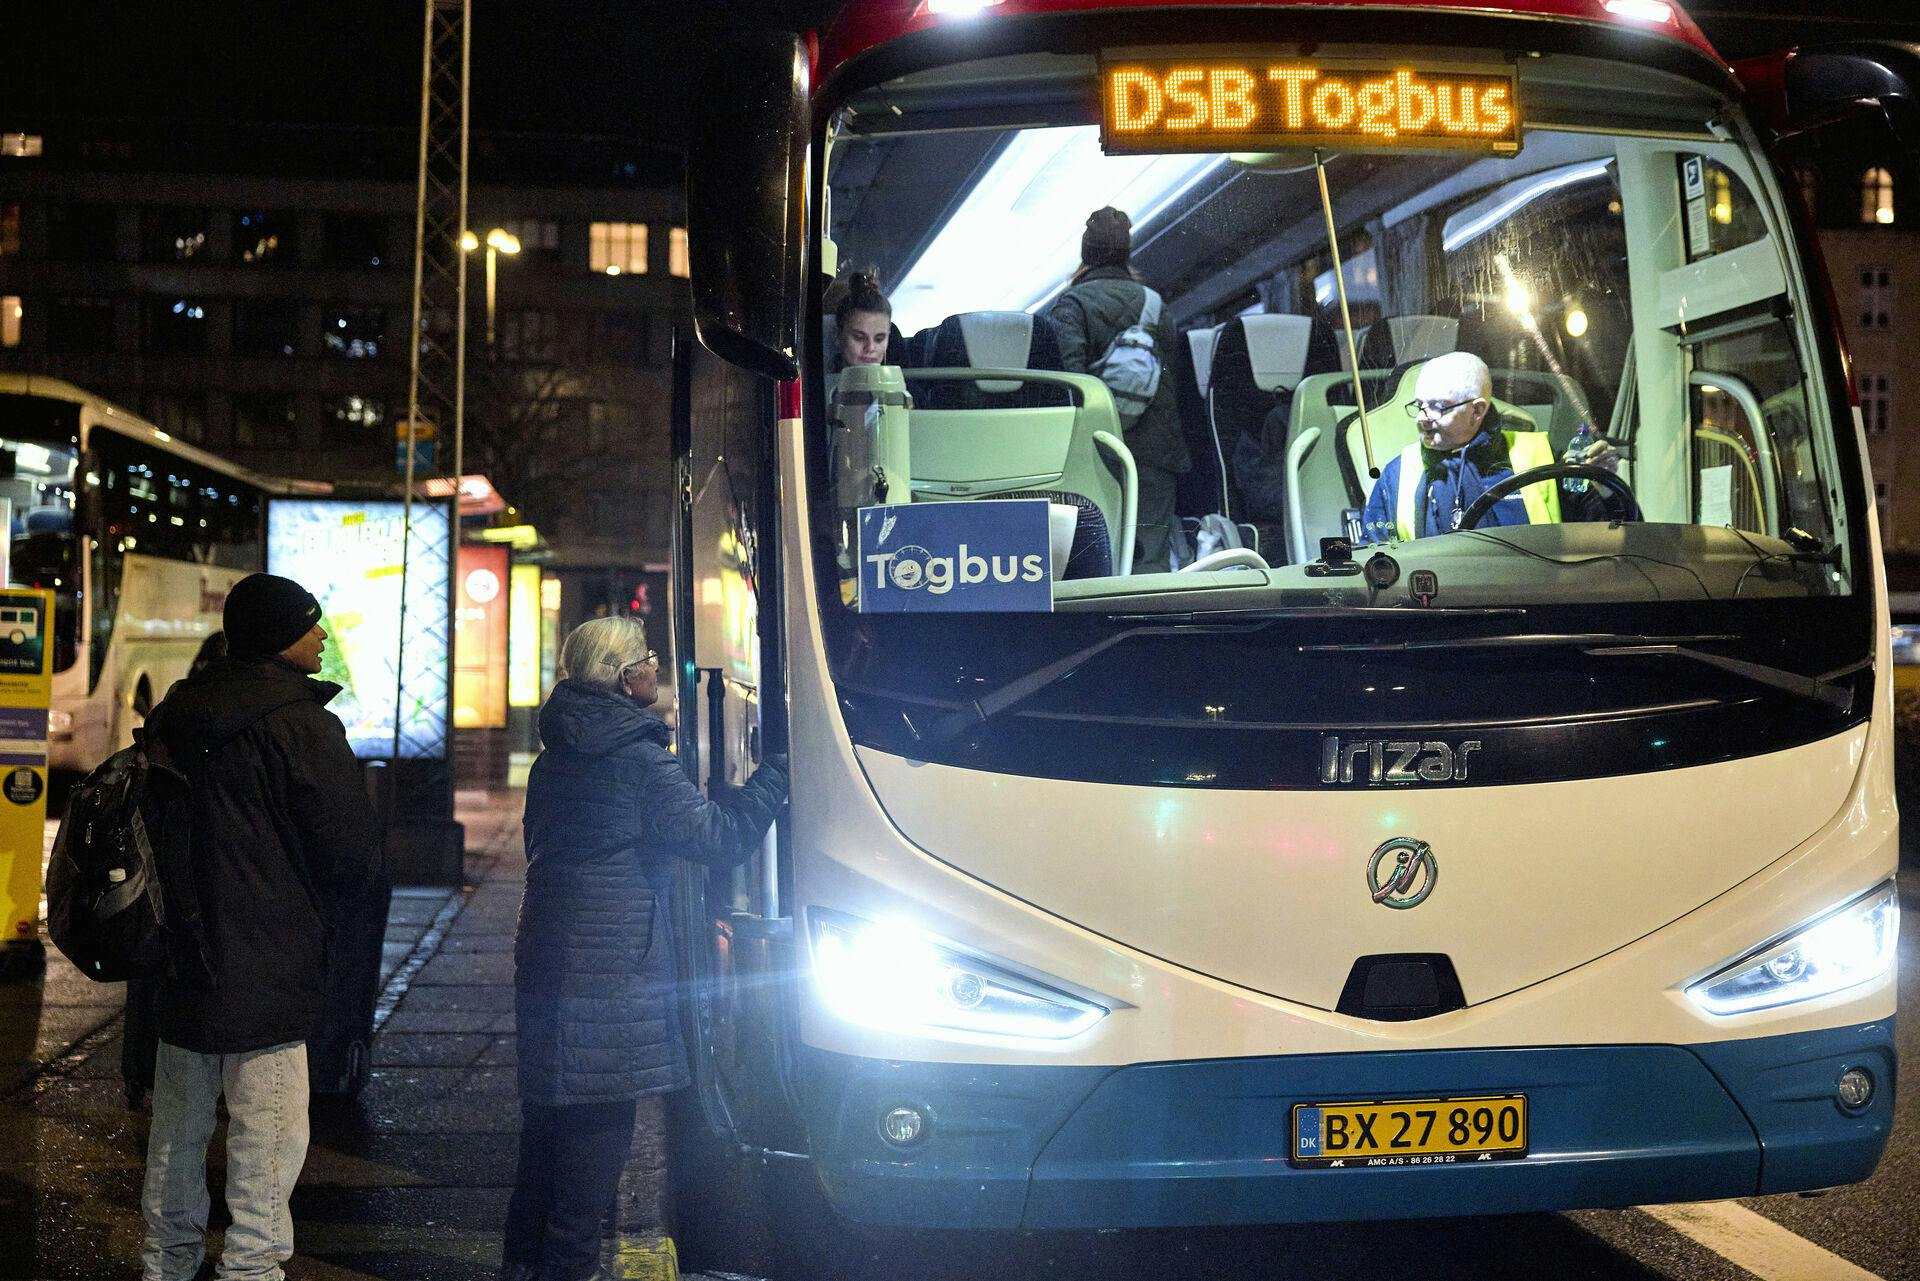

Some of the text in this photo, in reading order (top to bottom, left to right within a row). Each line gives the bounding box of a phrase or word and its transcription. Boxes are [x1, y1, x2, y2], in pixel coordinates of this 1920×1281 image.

[1113, 68, 1510, 138] DSB Togbus
[867, 544, 1044, 595] Togbus
[1321, 737, 1481, 783] Irizar
[1301, 1137, 1316, 1148] DK
[1326, 1105, 1519, 1150] BX 27 890
[1367, 1158, 1387, 1166] AMC
[1389, 1157, 1404, 1165] A/S
[1422, 1156, 1432, 1164] 26
